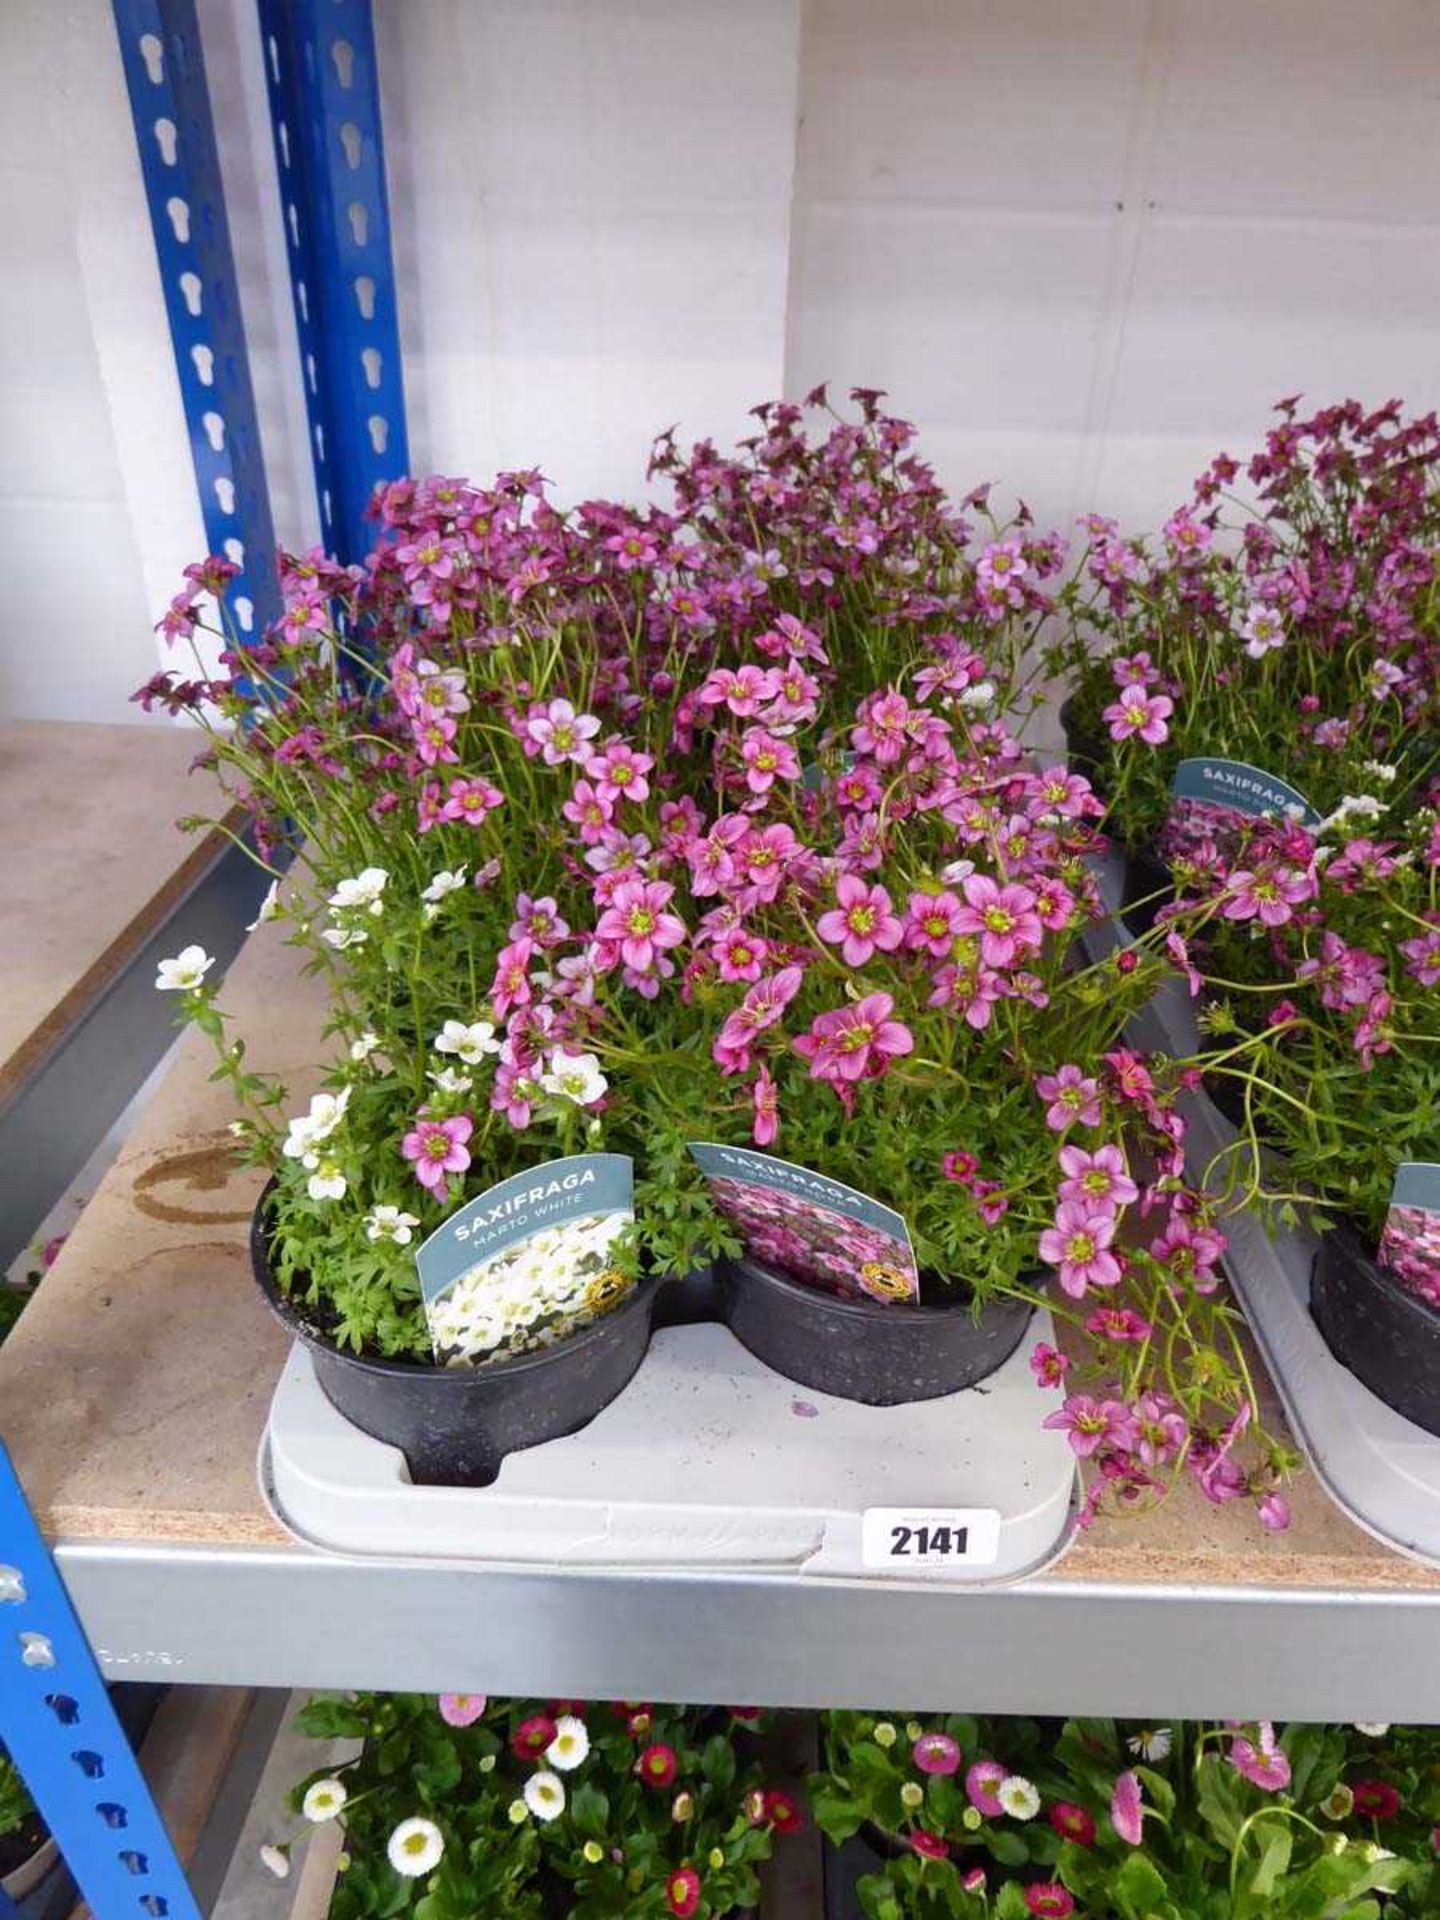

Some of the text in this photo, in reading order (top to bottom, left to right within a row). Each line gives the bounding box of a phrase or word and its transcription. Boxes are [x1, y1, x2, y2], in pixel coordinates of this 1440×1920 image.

[454, 1169, 595, 1241] SAXIFRAGA
[720, 1152, 862, 1206] SAXIFRAGA
[474, 1193, 584, 1248] MARTO WHITE
[890, 1526, 968, 1555] 2141
